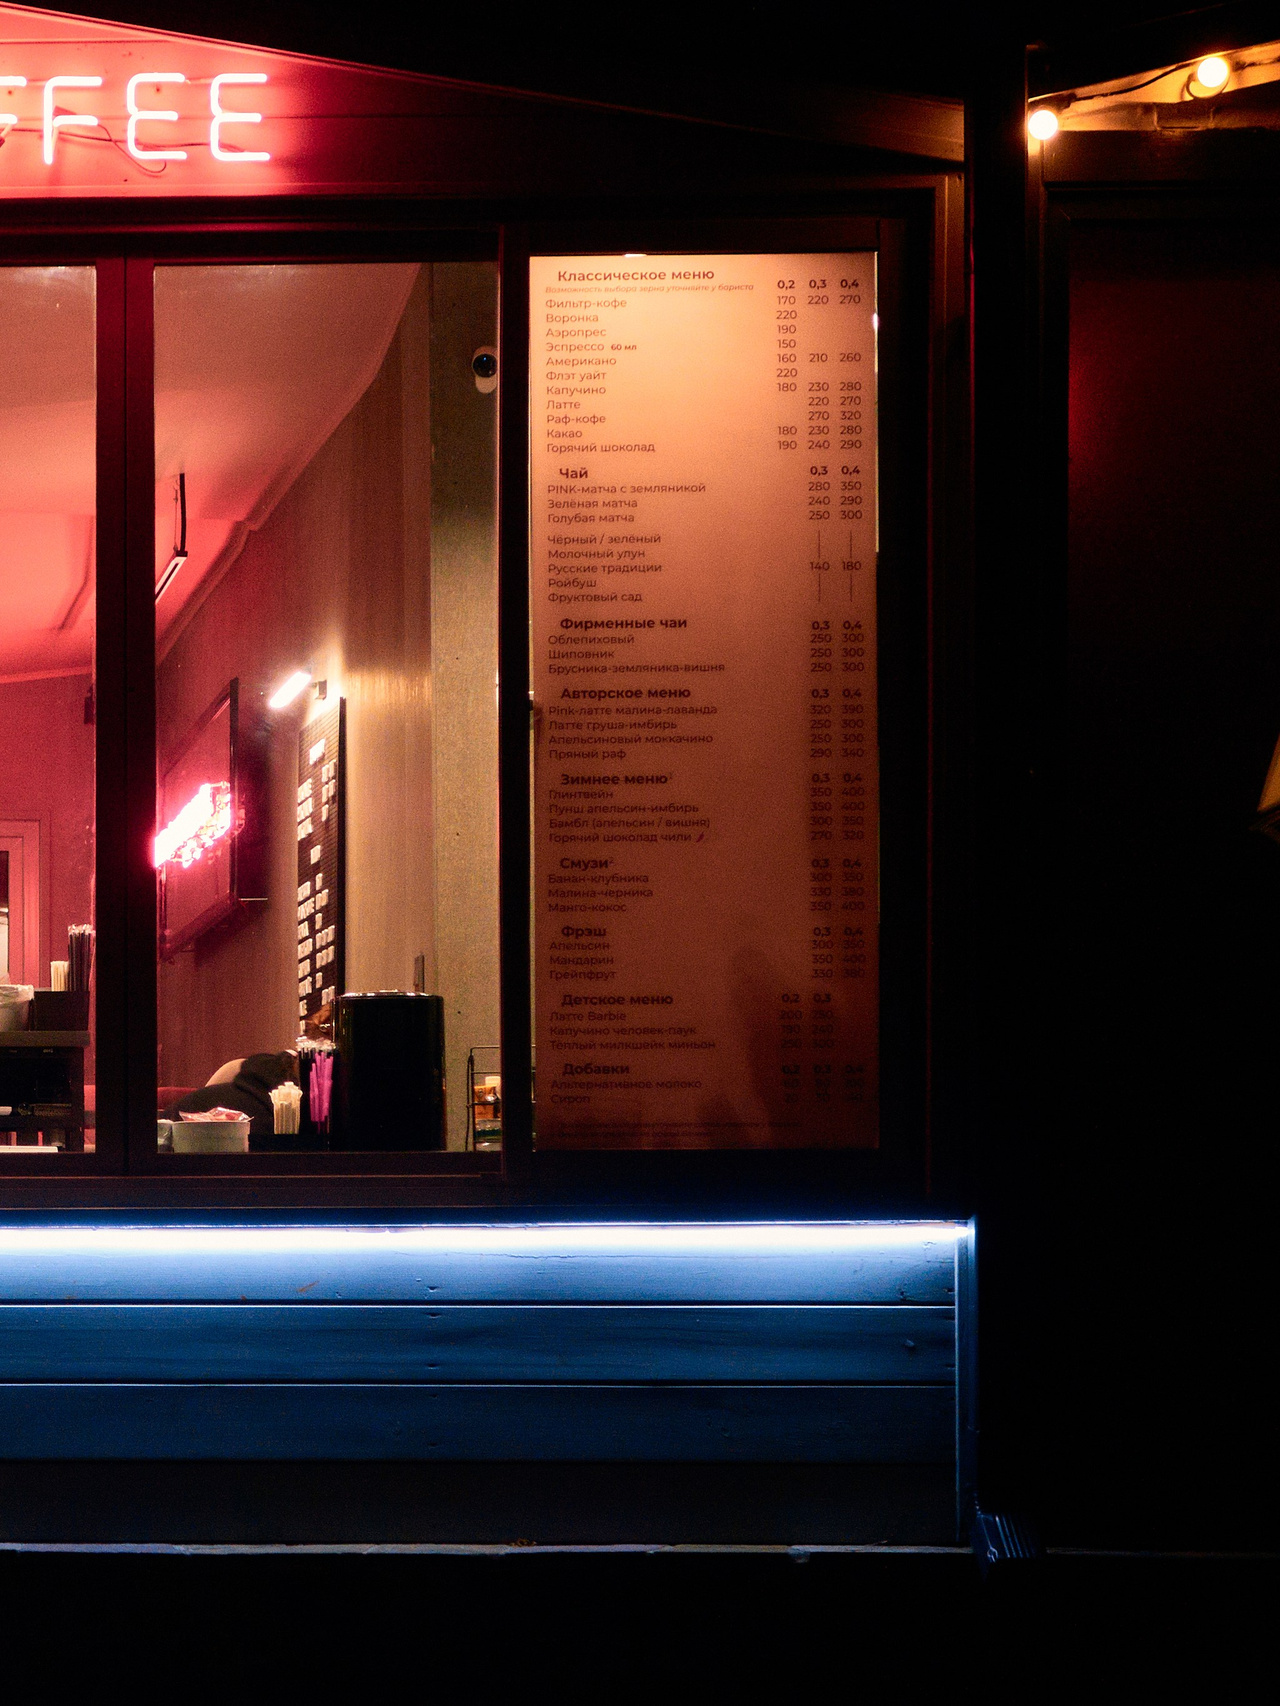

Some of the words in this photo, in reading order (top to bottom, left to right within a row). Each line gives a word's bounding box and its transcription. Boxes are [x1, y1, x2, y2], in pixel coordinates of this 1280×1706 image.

[558, 271, 667, 282] Классическое
[671, 270, 715, 280] меню
[777, 279, 795, 290] 0,2
[808, 279, 827, 290] 0,3
[840, 279, 859, 289] 0,4
[545, 299, 627, 309] Фильтр-кофе
[777, 296, 796, 305] 170
[808, 295, 829, 305] 220
[839, 295, 861, 305] 270
[546, 314, 599, 324] Воронка
[776, 310, 797, 320] 220
[546, 328, 607, 338] Аэропрес
[778, 324, 797, 334] 190
[546, 342, 605, 353] Эспрессо
[777, 339, 796, 348] 150
[546, 357, 617, 367] Американо
[777, 353, 797, 363] 160
[809, 353, 828, 363] 210
[840, 352, 862, 362] 260
[546, 371, 575, 380] Флэт
[580, 372, 606, 382] уайт
[776, 368, 798, 378] 220
[546, 386, 606, 397] Капучино
[777, 382, 797, 392] 180
[808, 382, 829, 392] 230
[840, 381, 862, 391] 280
[547, 400, 580, 409] Латте
[808, 397, 829, 406] 220
[840, 396, 861, 406] 270
[547, 414, 606, 425] Раф-кофе
[808, 411, 830, 421] 270
[841, 411, 861, 420] 320
[547, 430, 583, 439] Какао
[777, 425, 797, 436] 180
[808, 426, 829, 436] 230
[840, 425, 862, 435] 280
[547, 443, 597, 454] Горячий
[600, 443, 656, 453] шоколад
[778, 440, 797, 450] 190
[808, 440, 830, 450] 240
[840, 439, 862, 449] 290
[559, 467, 588, 479] Чай
[809, 465, 828, 476] 0,3
[841, 465, 861, 476] 0,4
[547, 485, 617, 494] PINK-матча
[620, 486, 626, 494] с
[631, 483, 706, 493] земляникой
[808, 481, 830, 491] 280
[841, 481, 862, 491] 350
[548, 499, 598, 509] Зелёная
[603, 500, 638, 509] матча
[808, 496, 830, 506] 240
[841, 496, 862, 505] 290
[548, 513, 595, 525] Голубая
[599, 515, 635, 523] матча
[808, 510, 830, 520] 250
[840, 510, 862, 520] 300
[547, 535, 597, 545] Чёрный
[609, 534, 661, 544] зелёный
[548, 550, 613, 559] Молочный
[618, 551, 645, 560] улун
[548, 564, 597, 575] Русские
[602, 565, 662, 574] традиции
[809, 561, 830, 571] 140
[842, 561, 862, 571] 180
[548, 578, 596, 589] Ройбуш
[548, 593, 618, 604] Фруктовый
[621, 594, 643, 603] сад
[560, 618, 656, 631] Фирменные
[659, 619, 688, 629] чаи
[810, 620, 830, 632] 0,3
[842, 620, 862, 634] 0,4
[548, 635, 634, 645] Облепиховый
[810, 633, 832, 644] 250
[843, 633, 864, 643] 300
[549, 651, 613, 660] Шиповник
[810, 648, 832, 658] 250
[843, 648, 864, 657] 300
[548, 664, 725, 675] Брусника-земляника-вишня
[810, 662, 832, 673] 250
[842, 662, 864, 672] 300
[560, 688, 643, 701] Авторское
[647, 689, 691, 698] меню
[809, 688, 830, 699] 0,3
[842, 688, 862, 699] 0,4
[549, 707, 611, 716] Pink-латте
[616, 706, 718, 715] малина-лаванда
[809, 704, 831, 715] 320
[843, 704, 863, 714] 390
[550, 722, 582, 730] Латте
[587, 720, 677, 731] груша-имбирь
[810, 719, 831, 730] 250
[842, 719, 864, 728] 300
[549, 736, 641, 745] Апельсиновый
[645, 735, 713, 744] моккачино
[810, 733, 832, 744] 250
[842, 733, 864, 743] 300
[549, 750, 598, 760] Пряный
[602, 749, 626, 760] раф
[809, 748, 832, 759] 290
[842, 748, 864, 757] 340
[561, 773, 621, 785] Зимнее
[549, 790, 613, 799] Глинтвейн
[549, 804, 583, 815] Пунш
[587, 803, 699, 814] апельсин-имбирь
[549, 818, 588, 828] Бамбл
[665, 818, 710, 829] вишня)
[549, 833, 599, 844] Горячий
[603, 834, 658, 843] шоколад
[660, 834, 692, 843] чили
